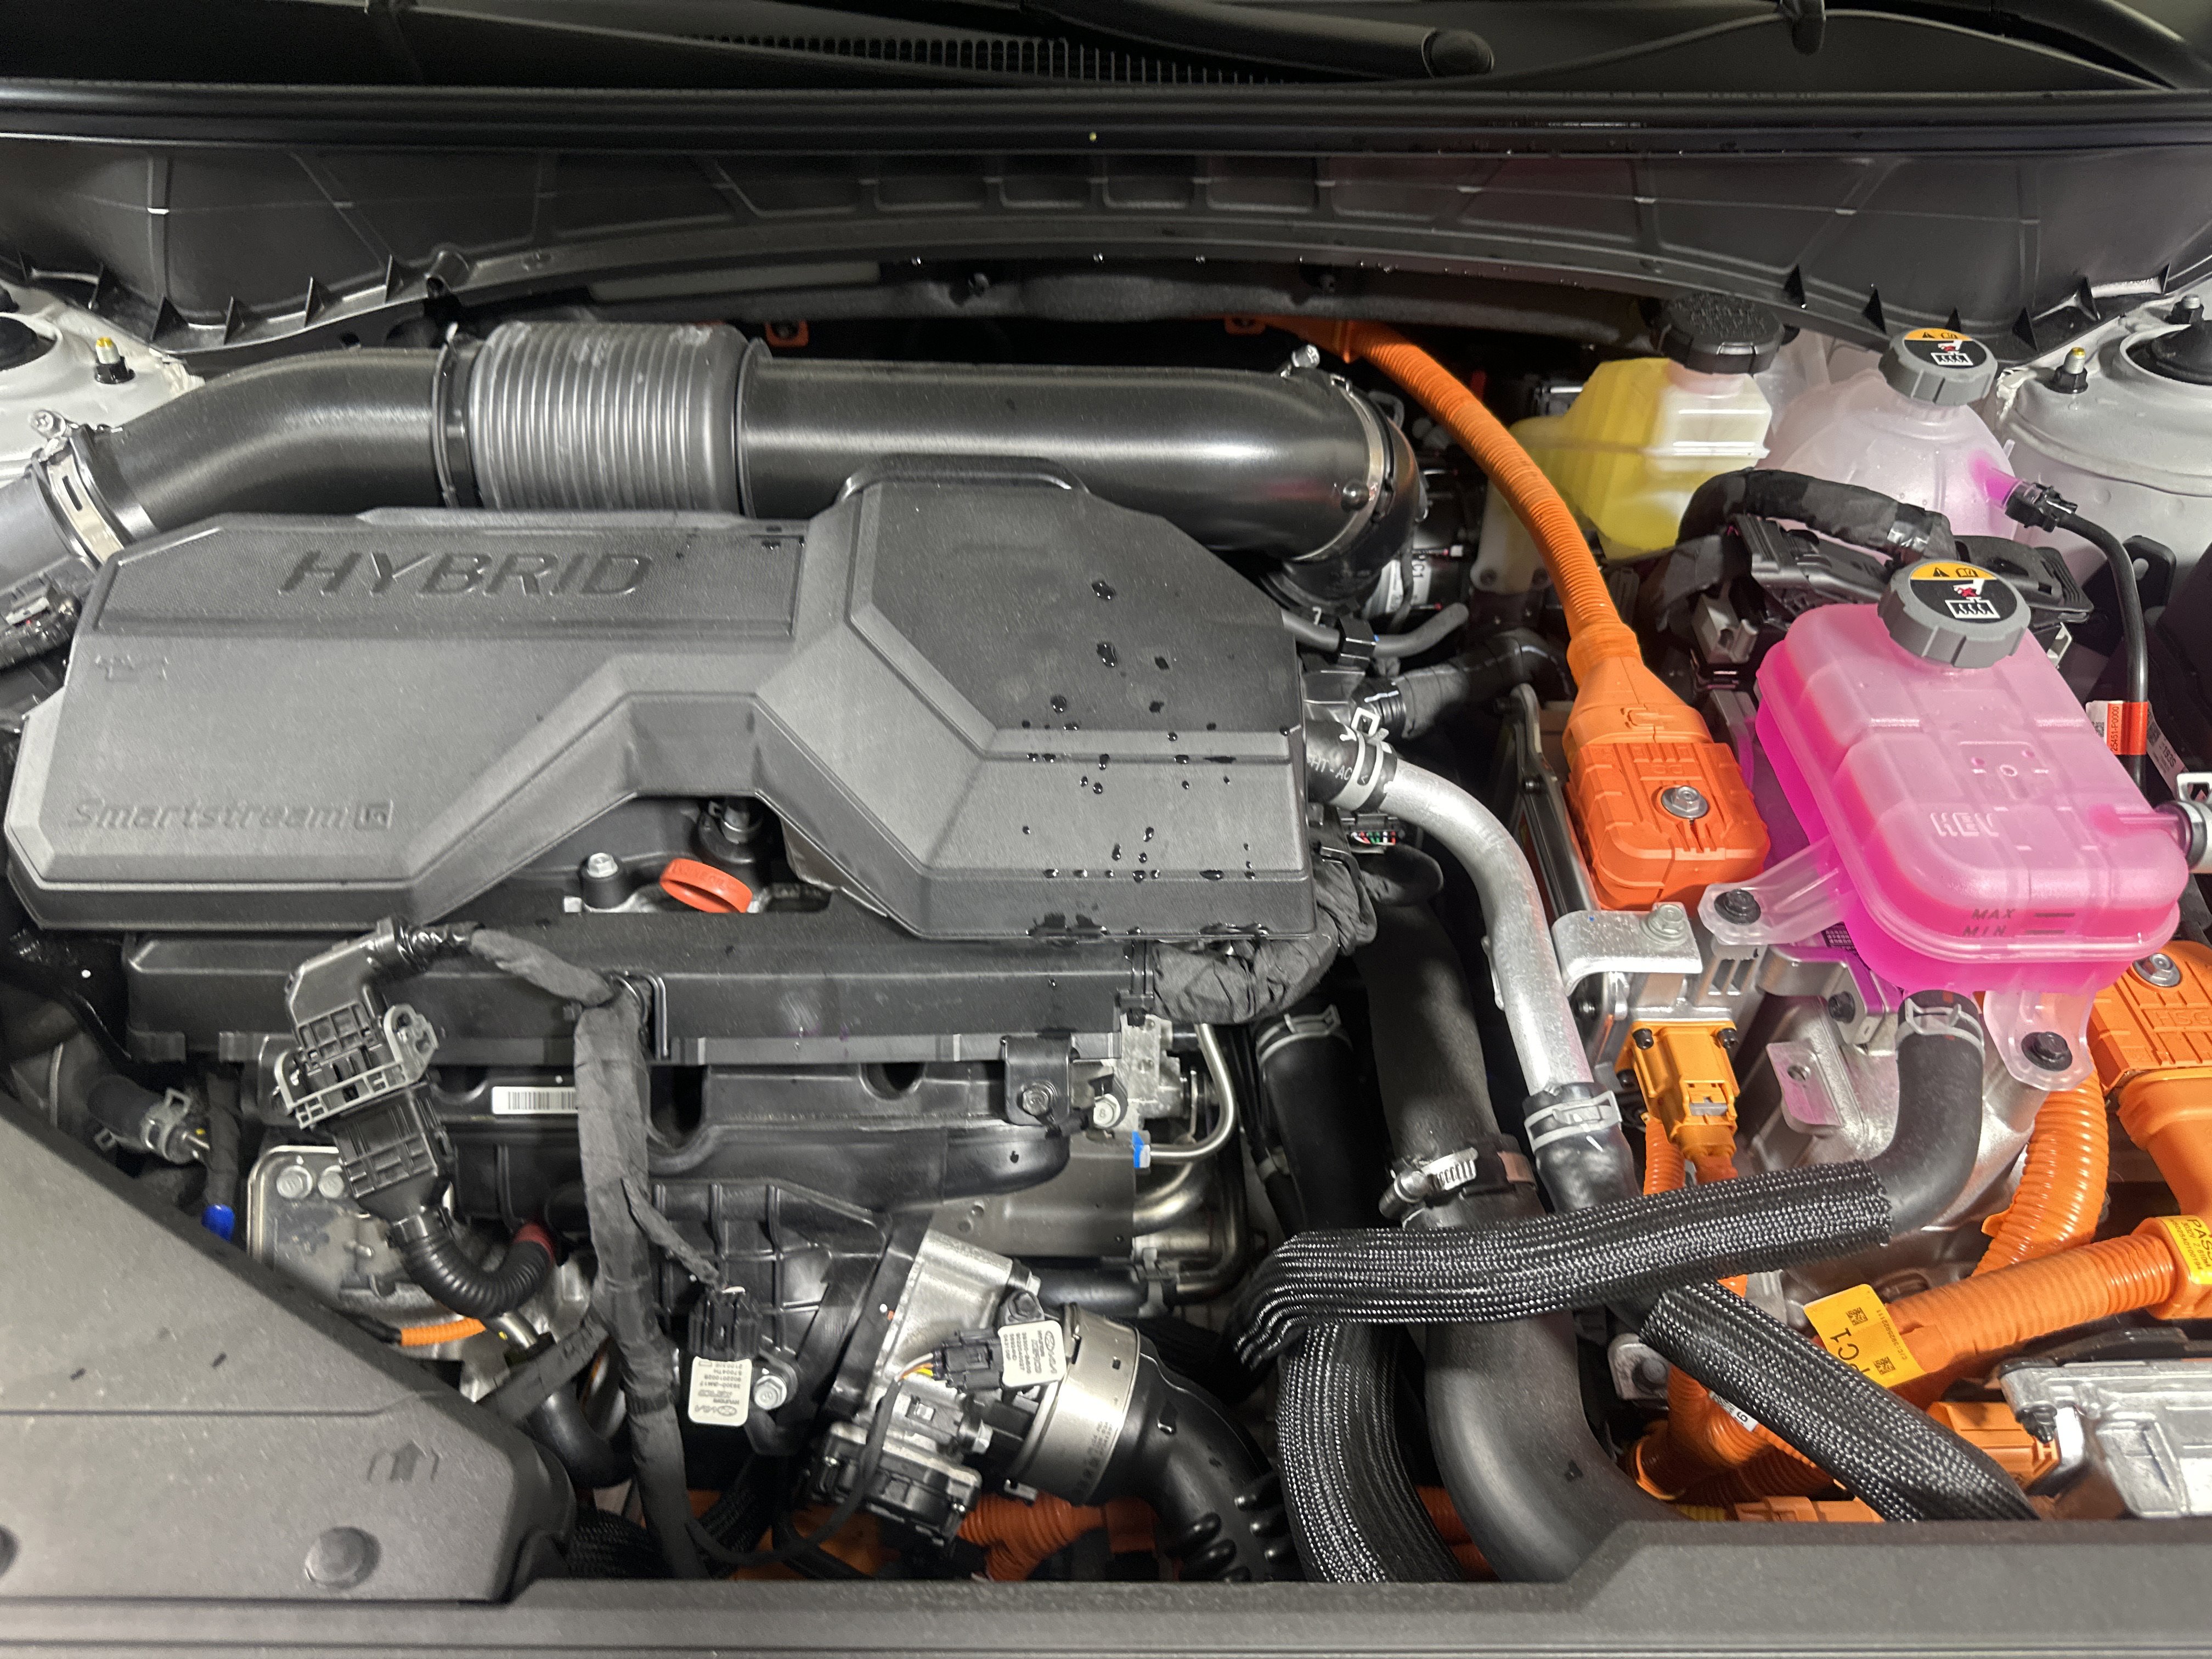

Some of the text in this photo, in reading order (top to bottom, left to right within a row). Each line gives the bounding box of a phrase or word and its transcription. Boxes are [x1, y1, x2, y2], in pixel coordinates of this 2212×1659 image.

[277, 551, 652, 596] HYBRID
[67, 799, 349, 829] Smartstream
[1972, 908, 2016, 921] MAX
[1962, 926, 2007, 937] MIN
